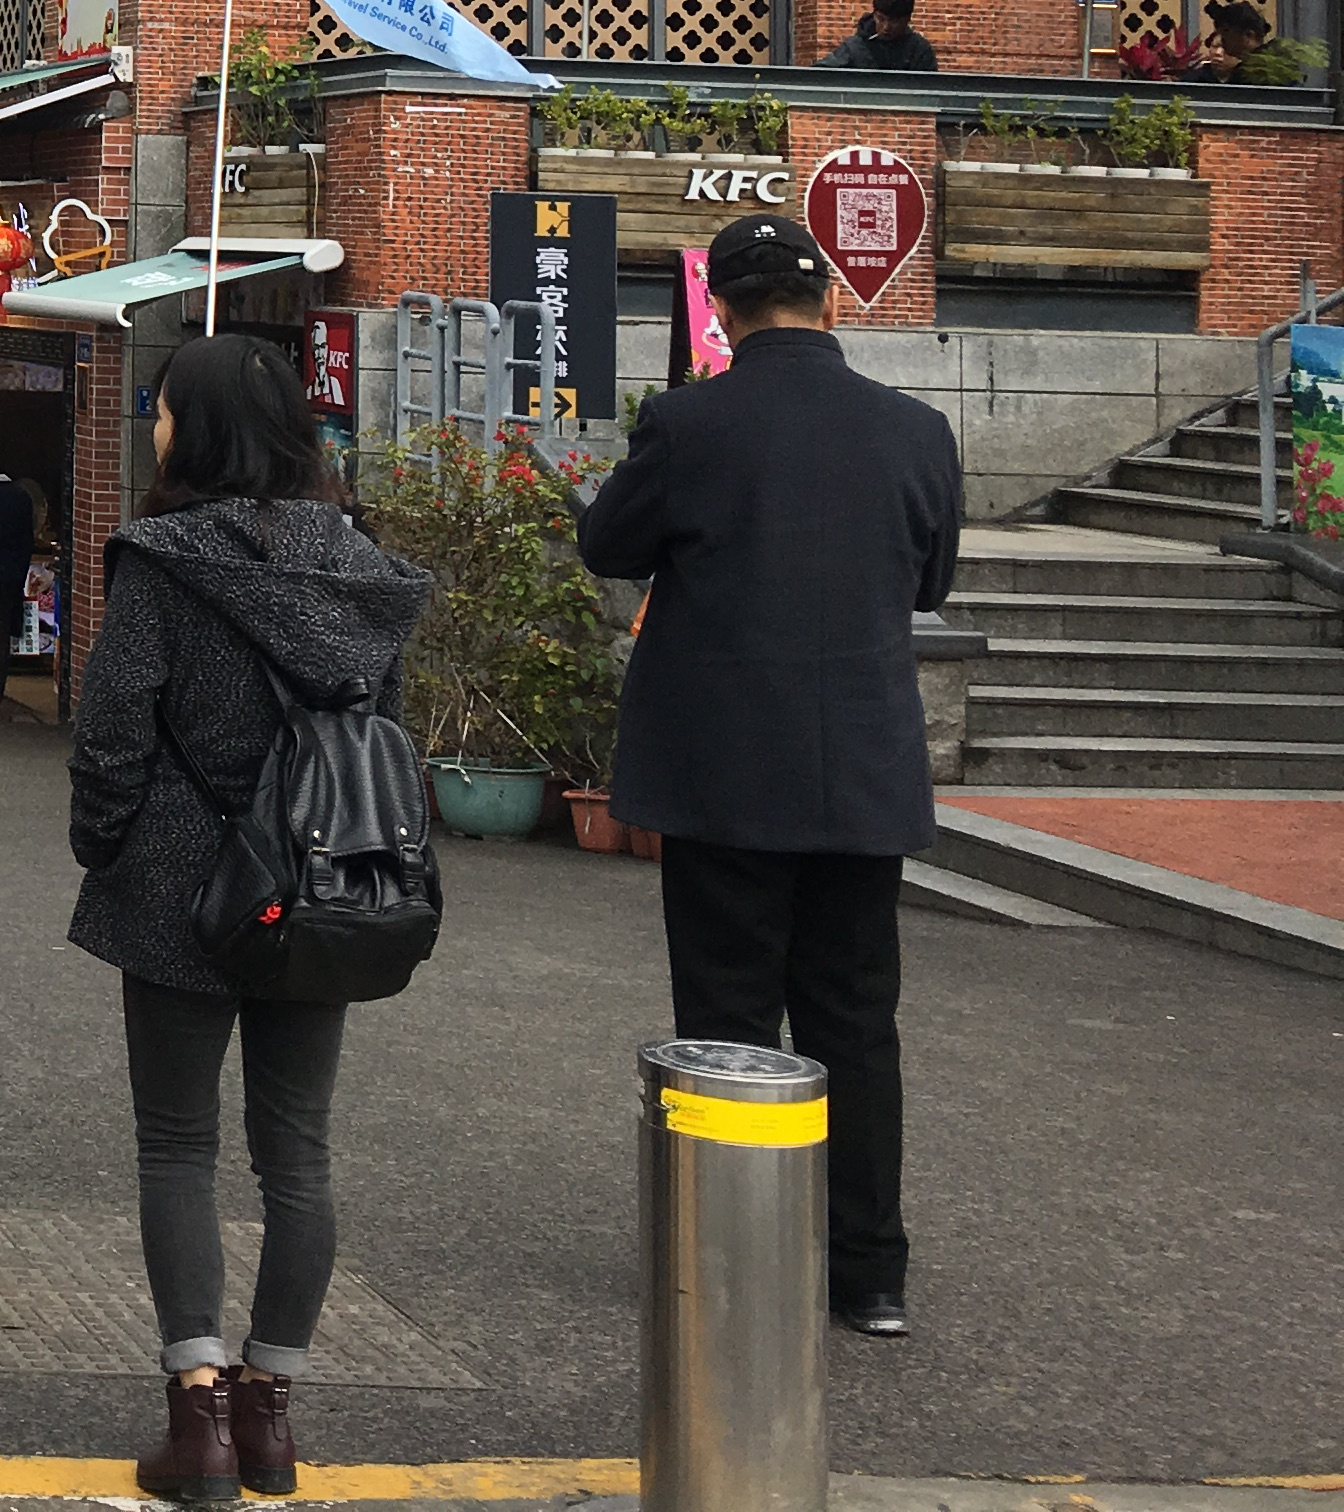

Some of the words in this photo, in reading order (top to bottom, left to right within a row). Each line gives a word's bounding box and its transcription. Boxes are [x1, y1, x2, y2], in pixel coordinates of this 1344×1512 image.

[369, 6, 408, 33] Service
[211, 164, 247, 193] FC
[684, 168, 790, 204] KFC
[822, 172, 865, 185] 手机扫码
[867, 173, 909, 185] 自在点餐
[535, 246, 569, 356] 豪客来
[328, 350, 350, 370] KFC
